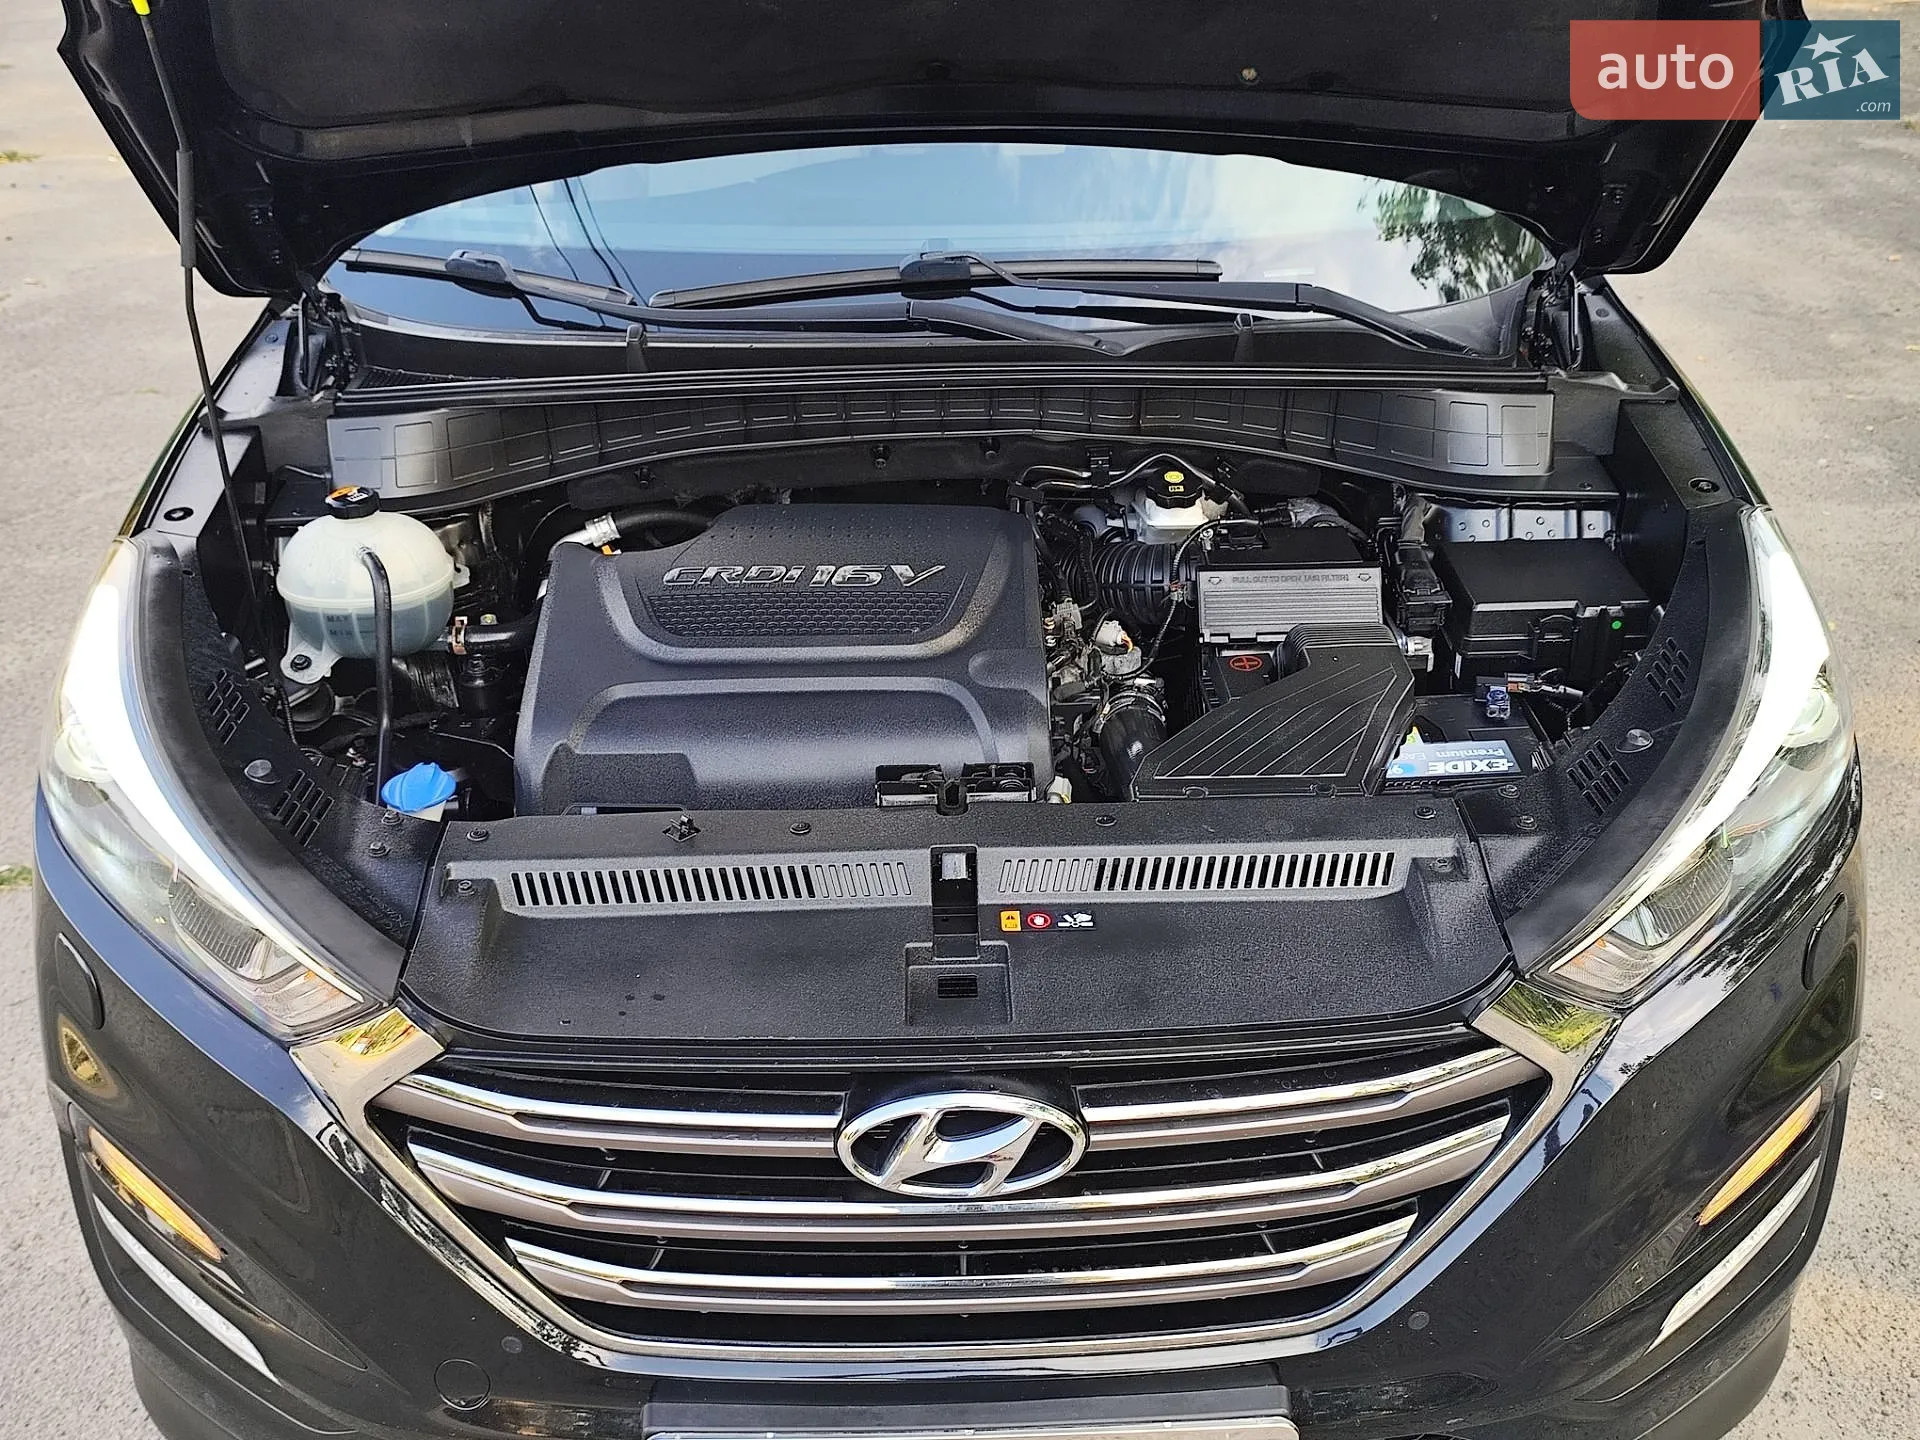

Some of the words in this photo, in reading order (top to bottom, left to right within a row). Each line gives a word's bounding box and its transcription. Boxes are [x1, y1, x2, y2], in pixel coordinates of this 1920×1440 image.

[809, 564, 947, 587] 16V
[1435, 748, 1505, 758] Premium
[1428, 758, 1513, 775] EXIDE
